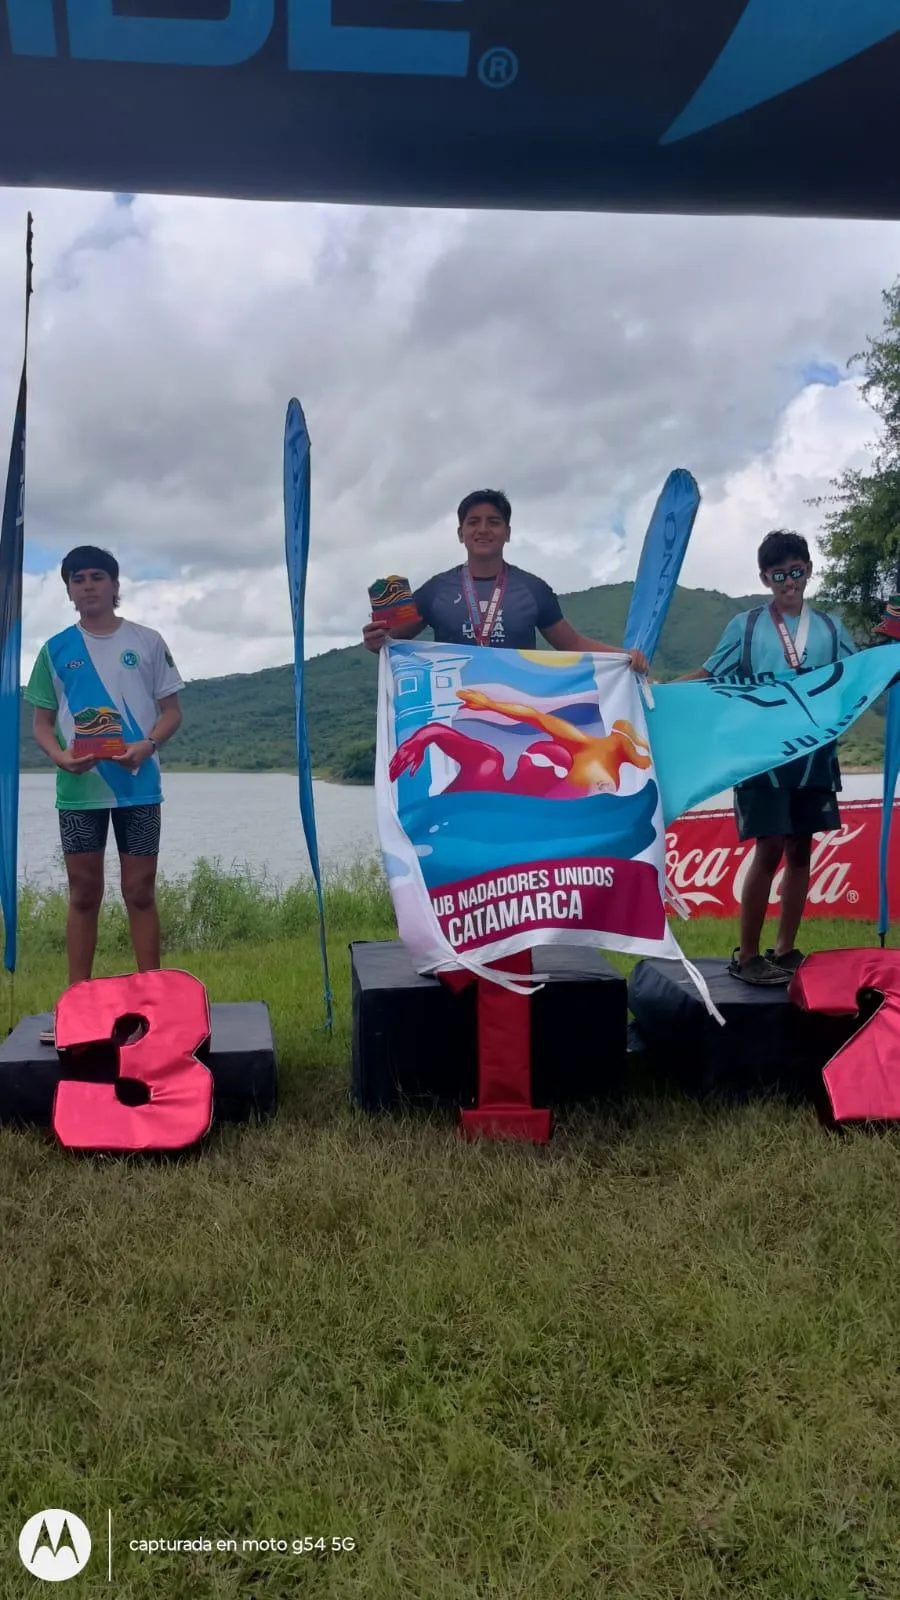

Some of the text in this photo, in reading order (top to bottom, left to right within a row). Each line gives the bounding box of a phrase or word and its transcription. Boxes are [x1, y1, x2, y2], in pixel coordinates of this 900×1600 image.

[433, 866, 615, 918] UB NADADORES UNIDOS
[447, 890, 583, 948] CATAMARCA
[53, 968, 215, 1153] 3
